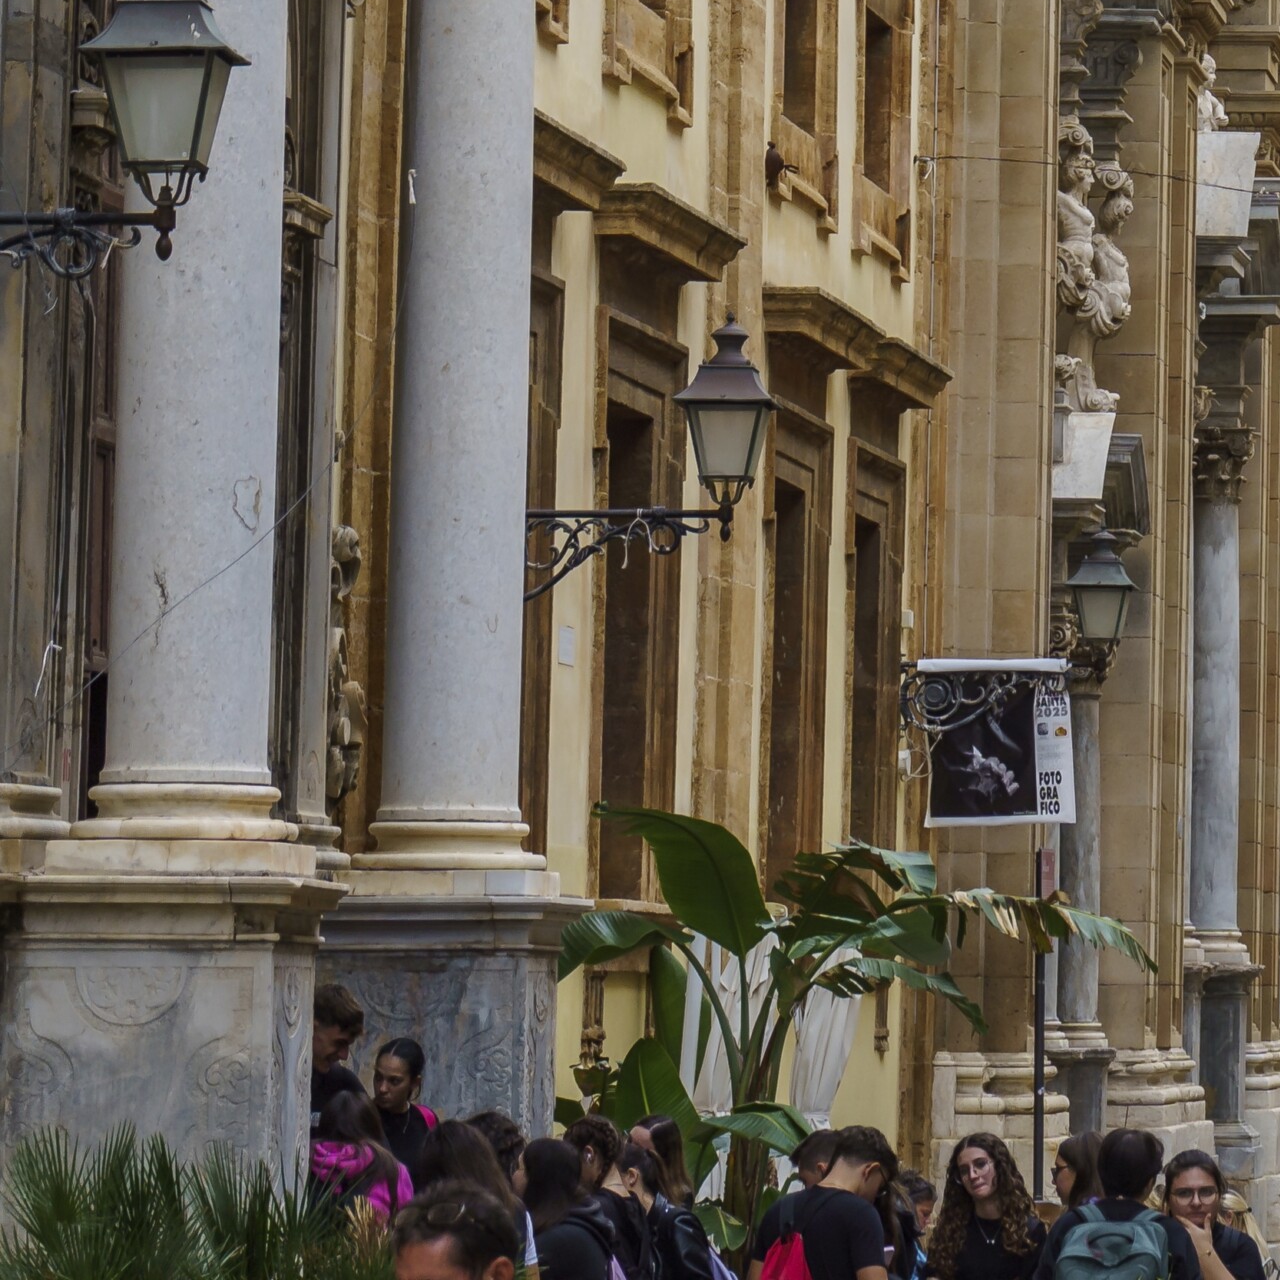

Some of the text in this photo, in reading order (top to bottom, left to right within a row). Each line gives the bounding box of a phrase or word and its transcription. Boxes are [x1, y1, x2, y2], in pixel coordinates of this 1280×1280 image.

[1036, 707, 1068, 717] 2025
[1039, 771, 1062, 785] FOTO
[1039, 786, 1059, 800] GRA
[1040, 801, 1060, 815] FICO
